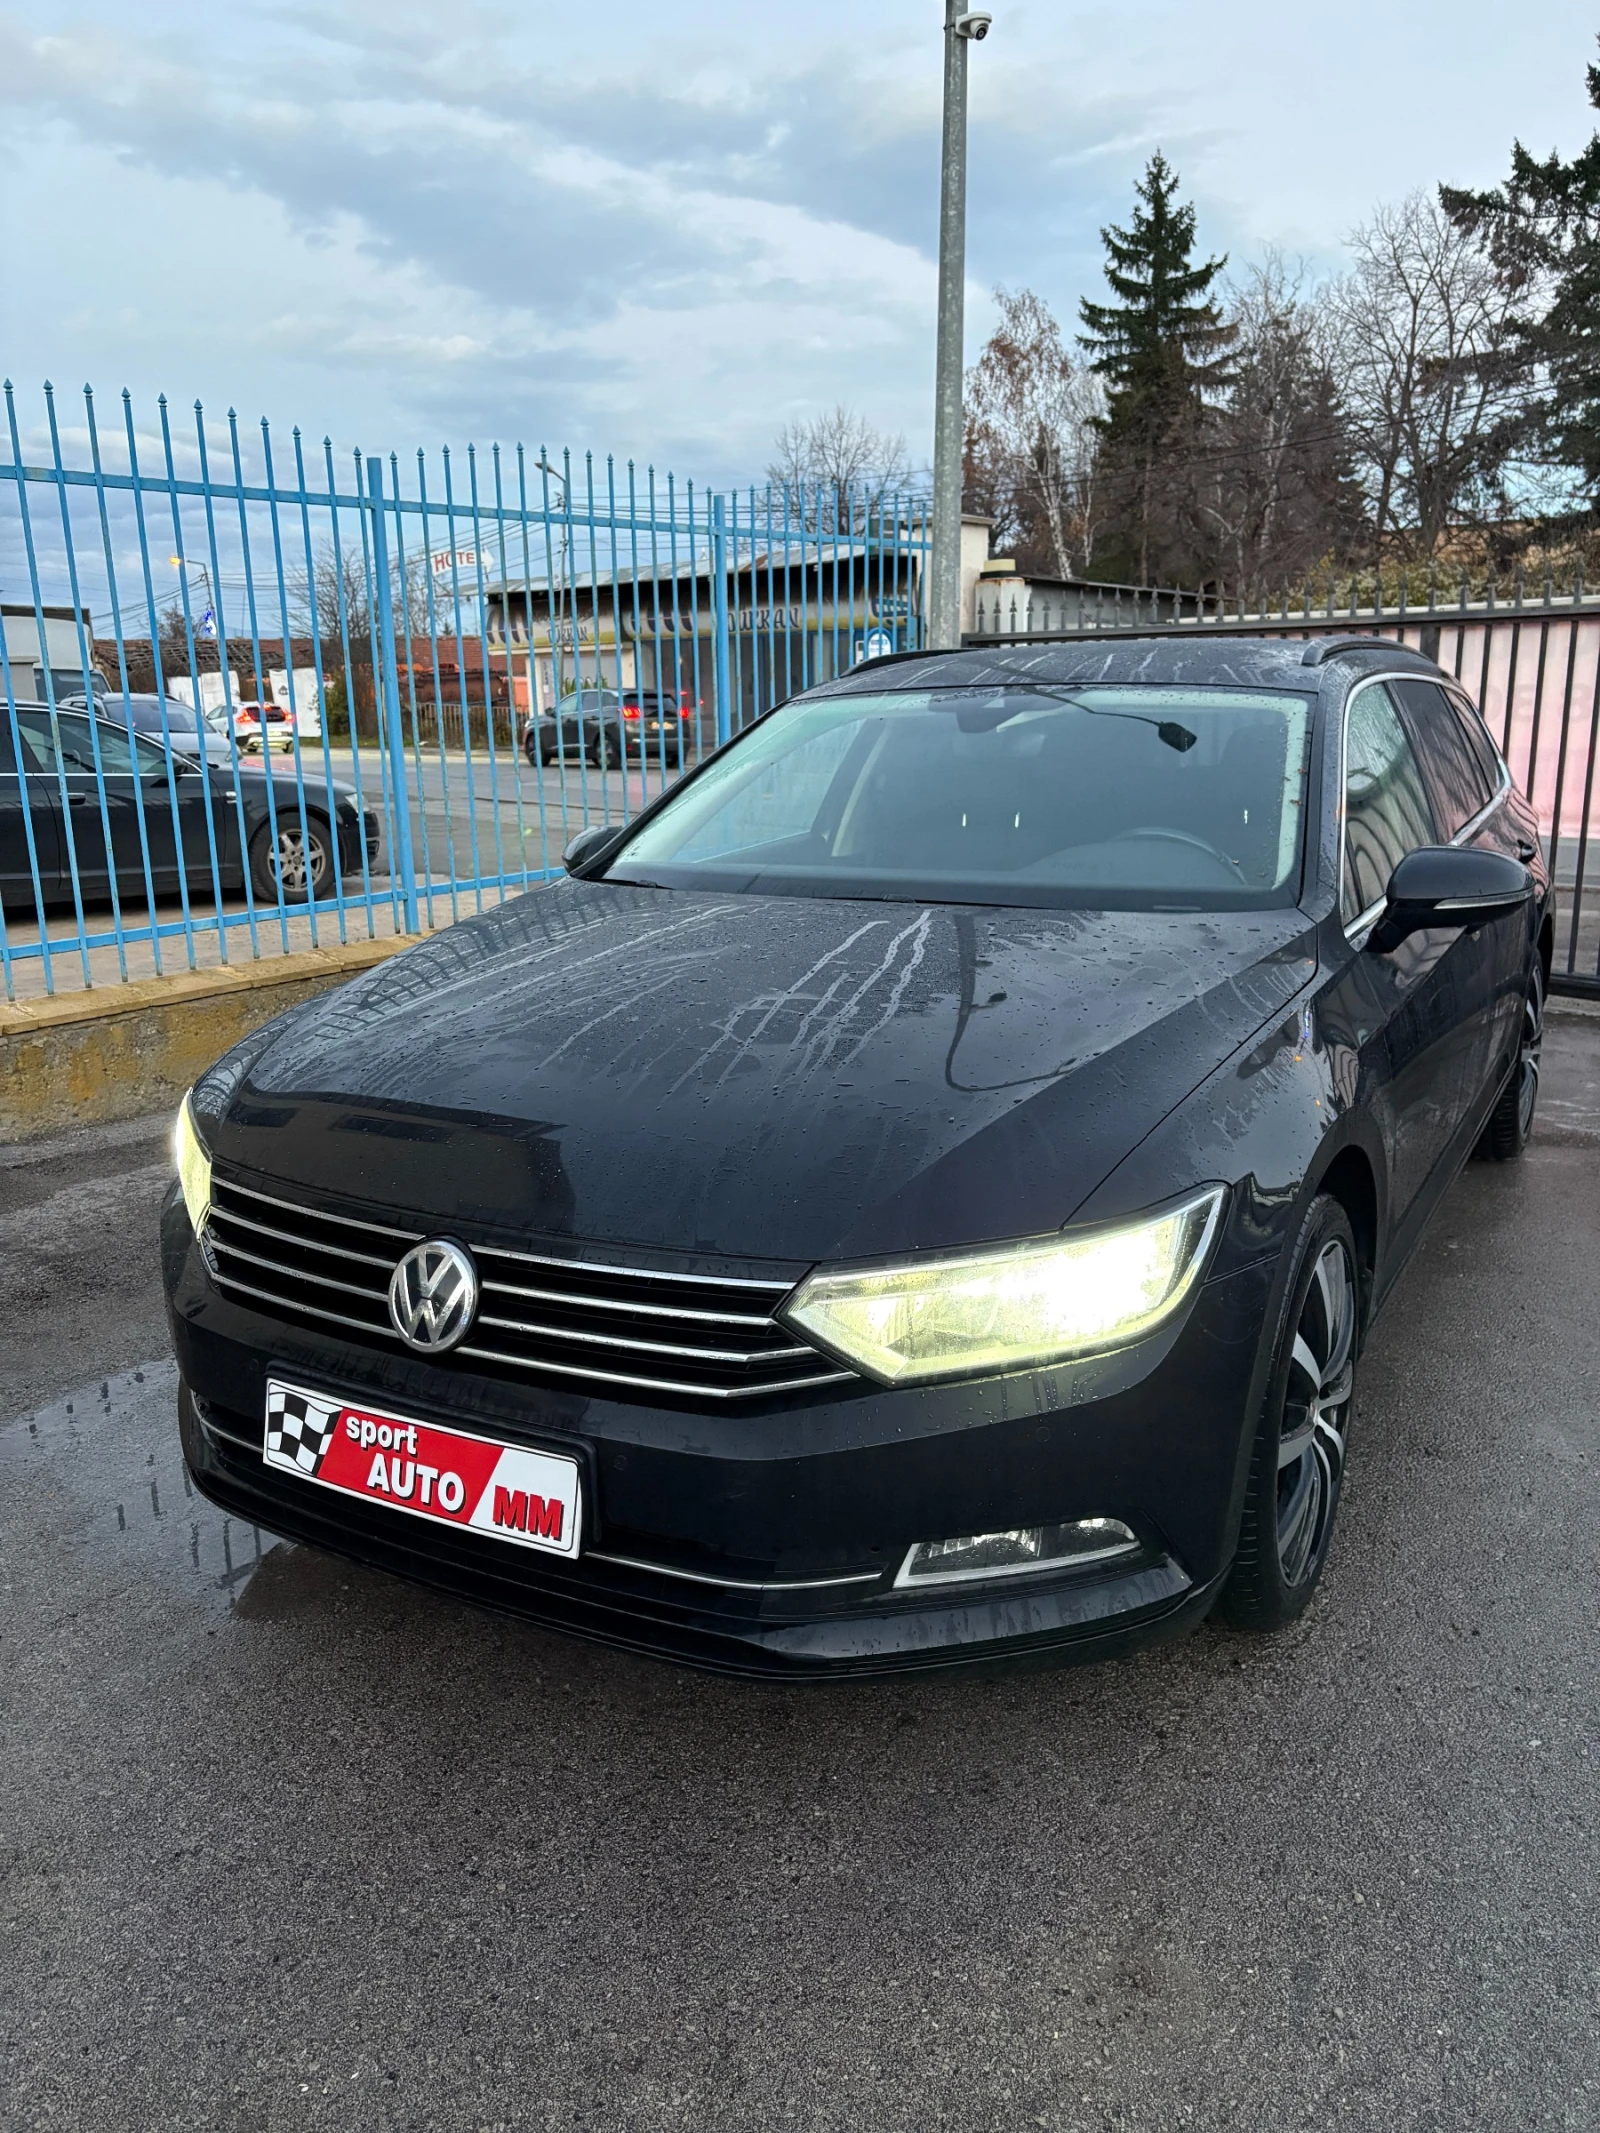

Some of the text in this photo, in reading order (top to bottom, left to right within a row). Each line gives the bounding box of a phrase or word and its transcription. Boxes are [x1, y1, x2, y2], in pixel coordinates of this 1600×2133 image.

[434, 550, 484, 572] HOTE
[392, 1244, 473, 1349] VW
[346, 1415, 418, 1458] sport
[366, 1453, 564, 1541] AUTO MM
